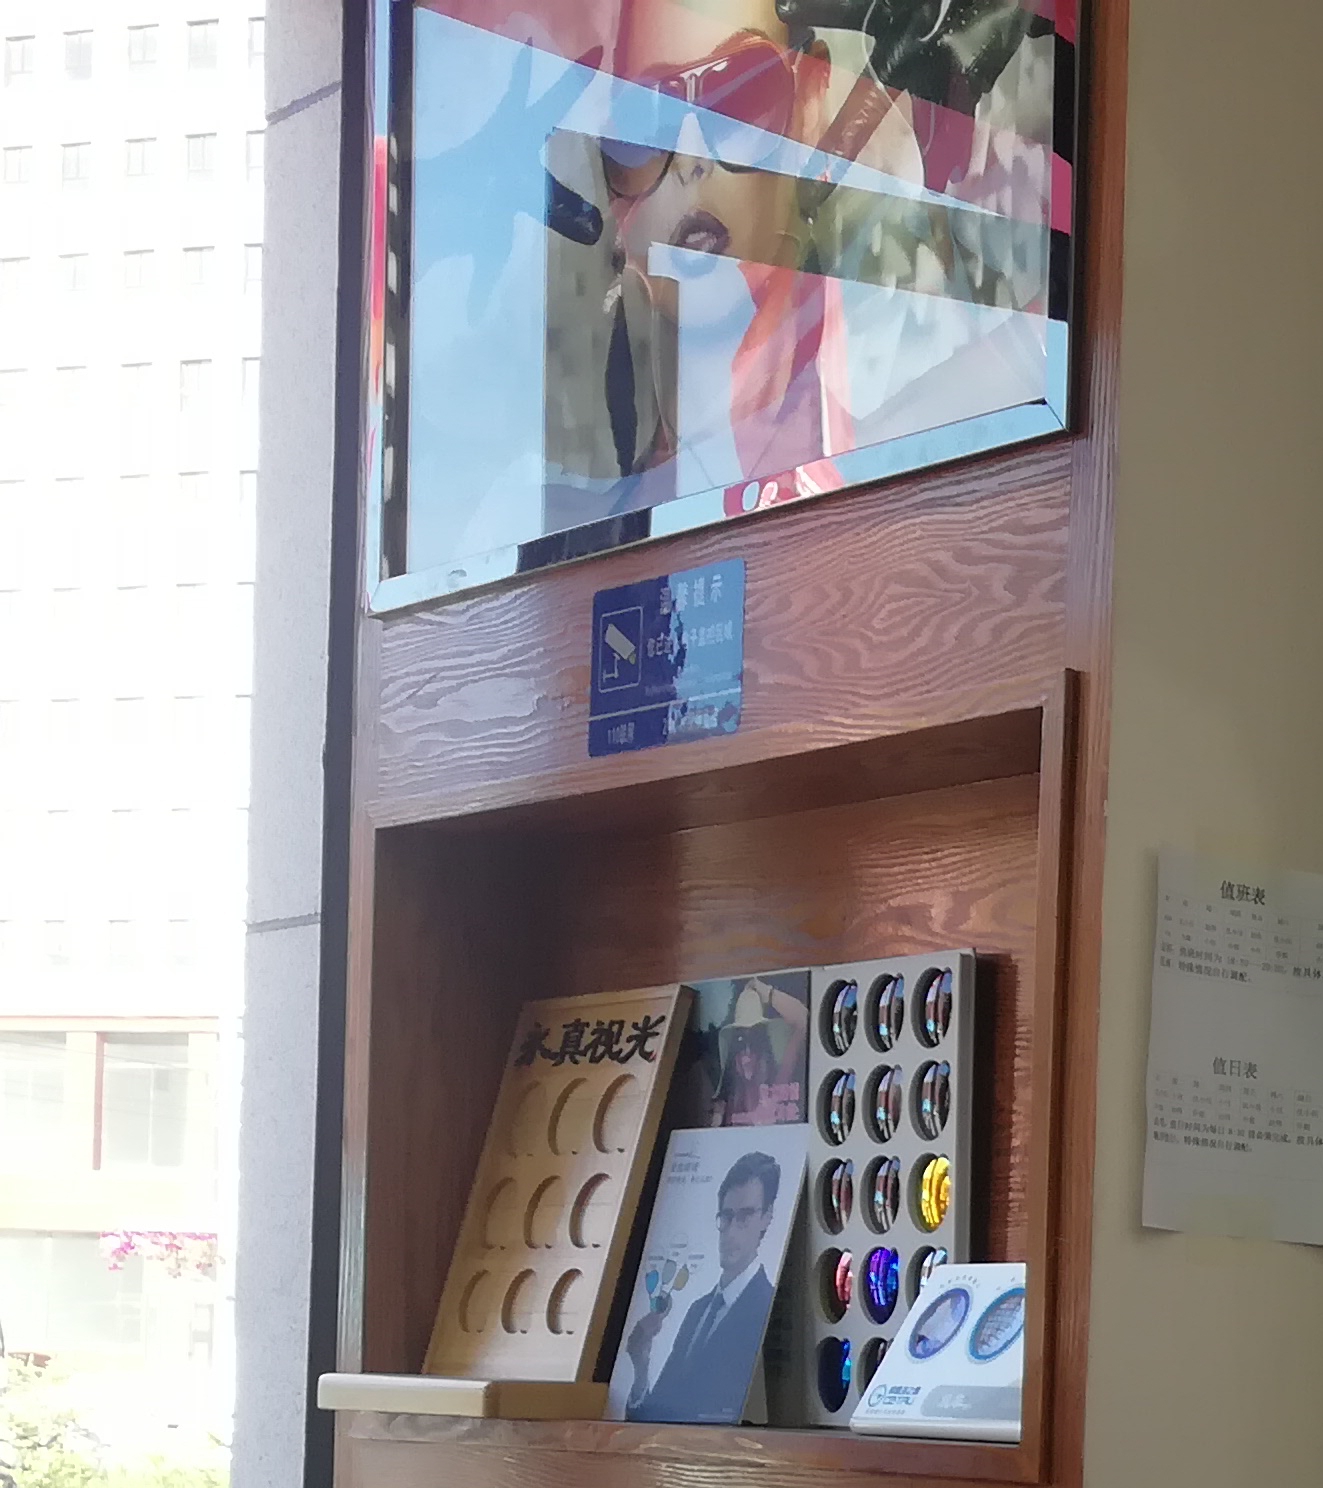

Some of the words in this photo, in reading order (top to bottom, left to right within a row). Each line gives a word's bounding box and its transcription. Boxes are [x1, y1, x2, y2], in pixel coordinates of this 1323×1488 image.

[1219, 880, 1266, 906] 值班表
[1212, 1057, 1258, 1080] 值日表
